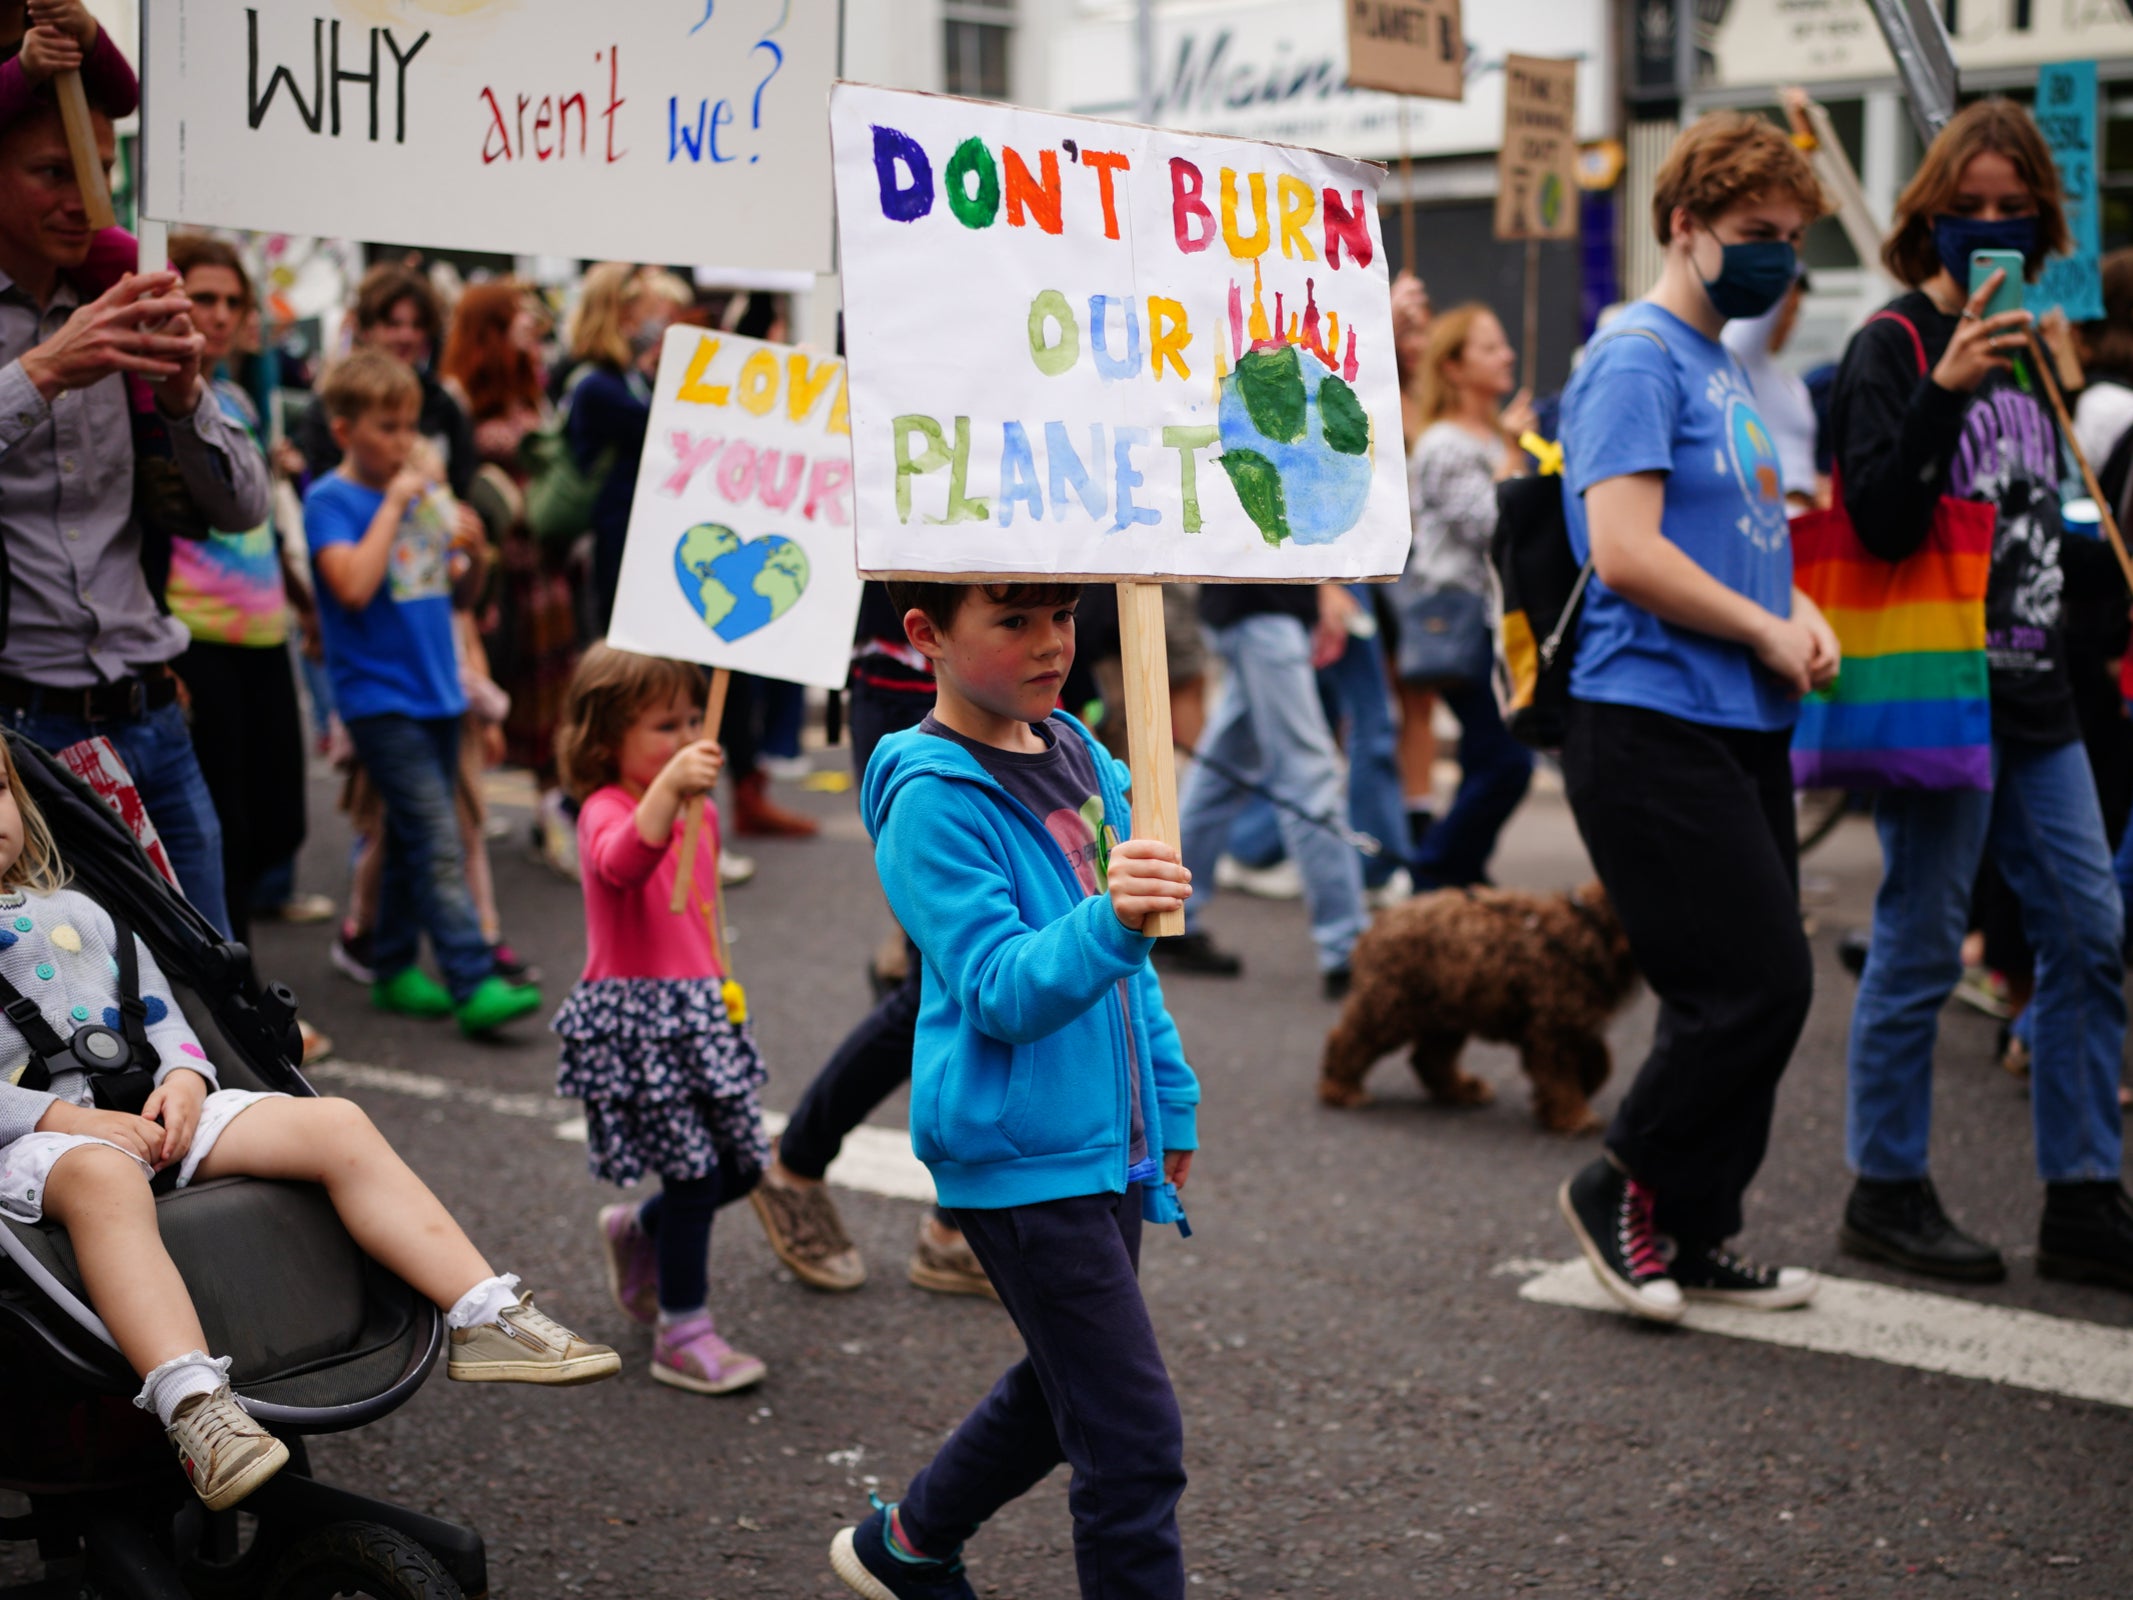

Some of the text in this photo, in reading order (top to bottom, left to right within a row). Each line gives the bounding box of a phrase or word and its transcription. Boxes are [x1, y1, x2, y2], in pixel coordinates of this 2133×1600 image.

[245, 8, 430, 143] WHY
[479, 41, 783, 164] aren't we?
[869, 123, 1131, 240] DON'T
[1169, 157, 1374, 270] BURN
[1027, 289, 1193, 383] OUR
[662, 431, 851, 525] YOUR
[891, 414, 1219, 536] PLANET
